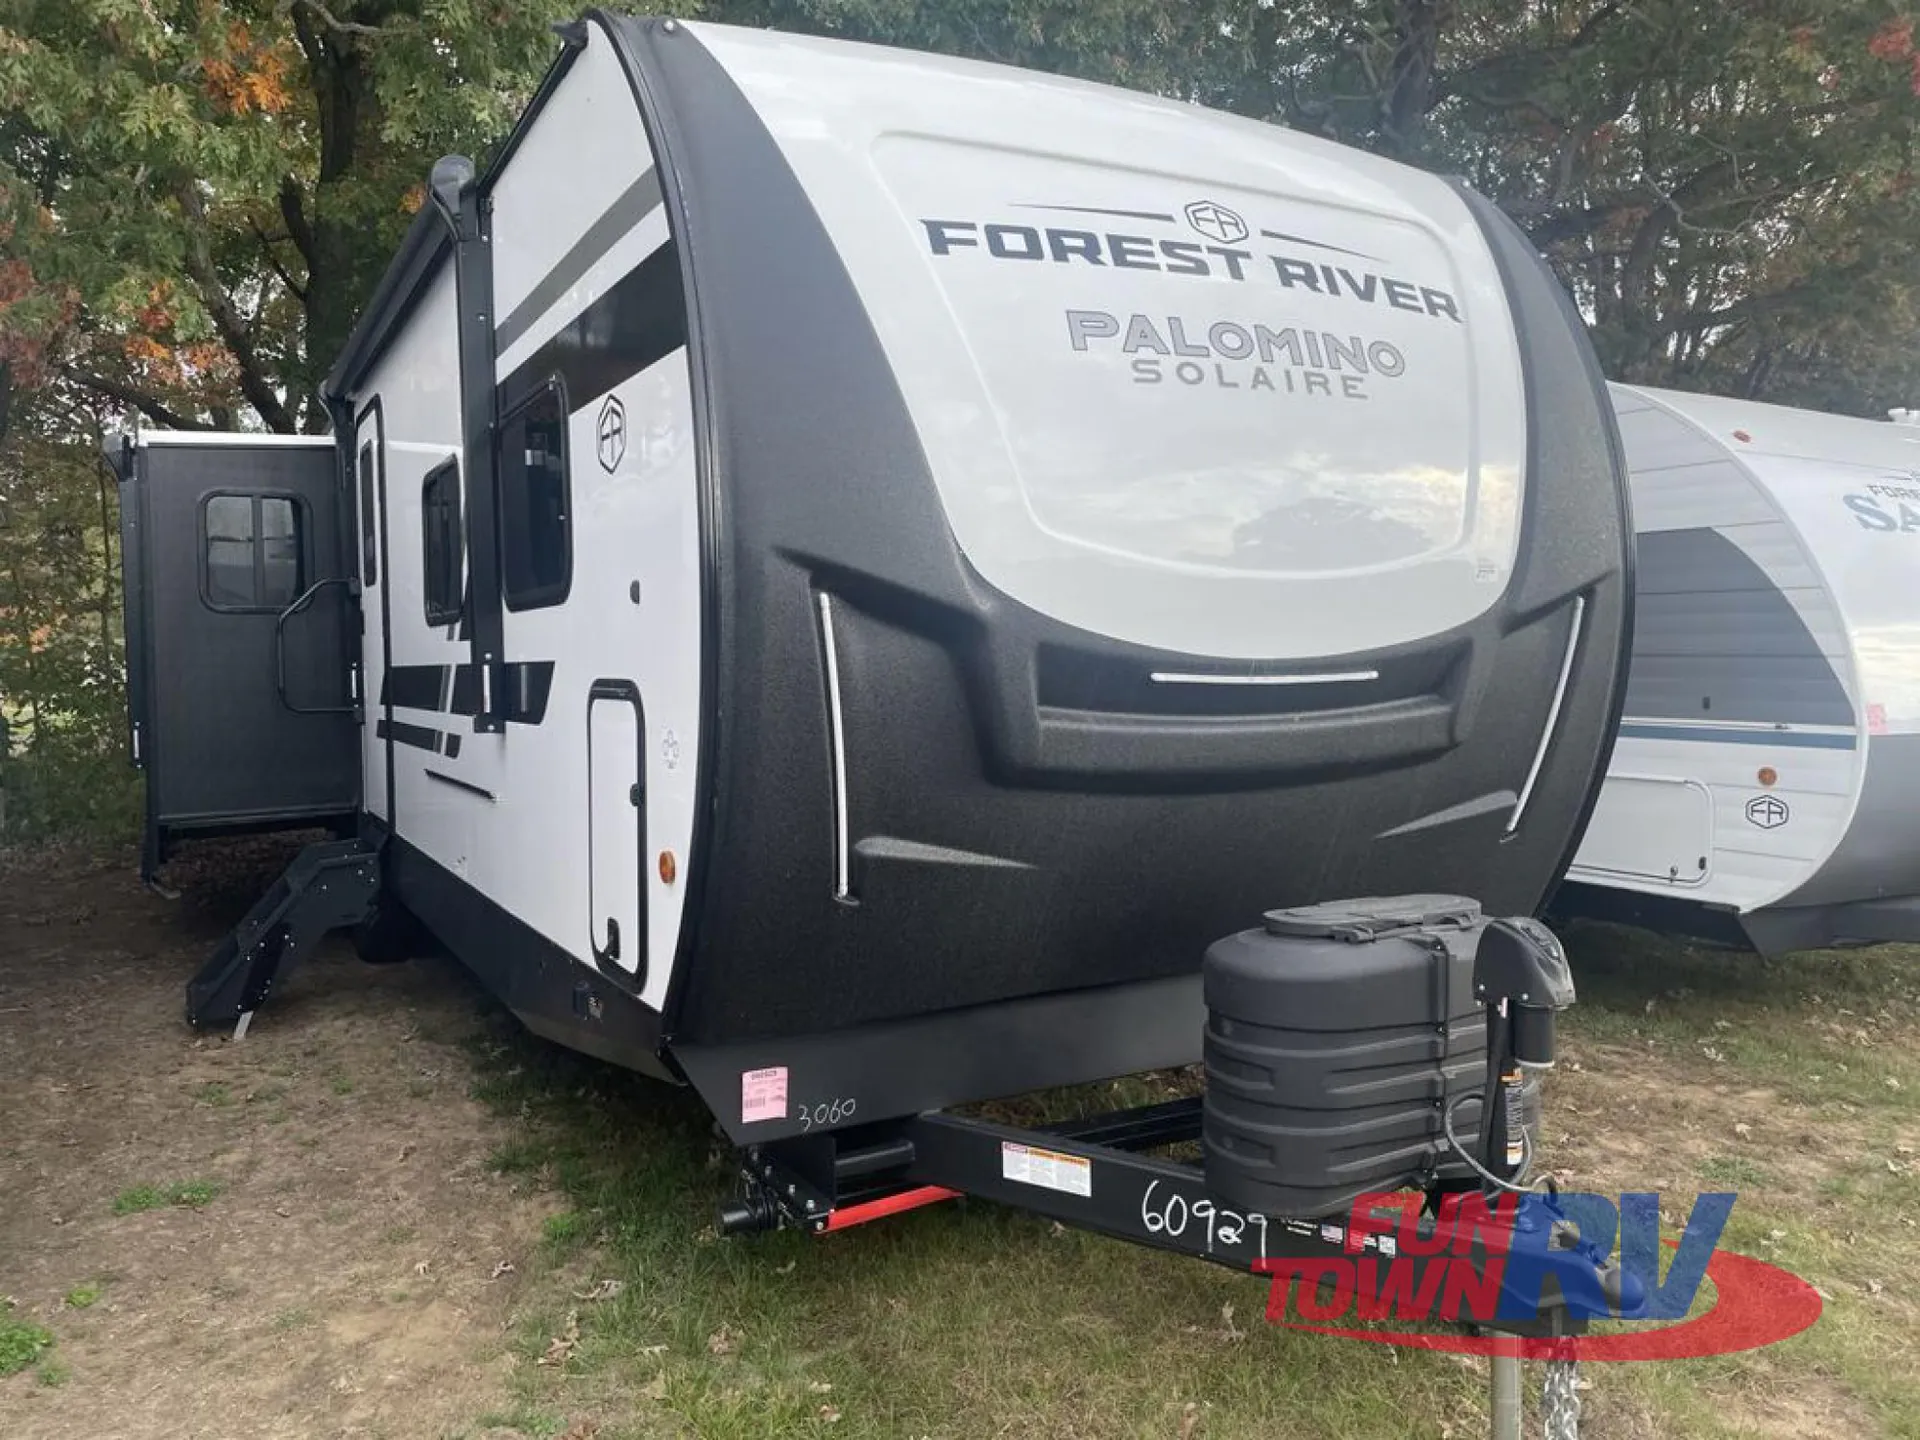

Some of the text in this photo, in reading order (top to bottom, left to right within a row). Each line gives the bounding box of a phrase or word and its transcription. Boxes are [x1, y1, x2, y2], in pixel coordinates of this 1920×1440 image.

[919, 219, 1462, 323] FOREST RIVER
[1066, 308, 1406, 378] PALOMINO
[1132, 358, 1368, 400] SOLAIRE
[798, 1098, 856, 1132] 3060
[1141, 1179, 1268, 1269] 60929
